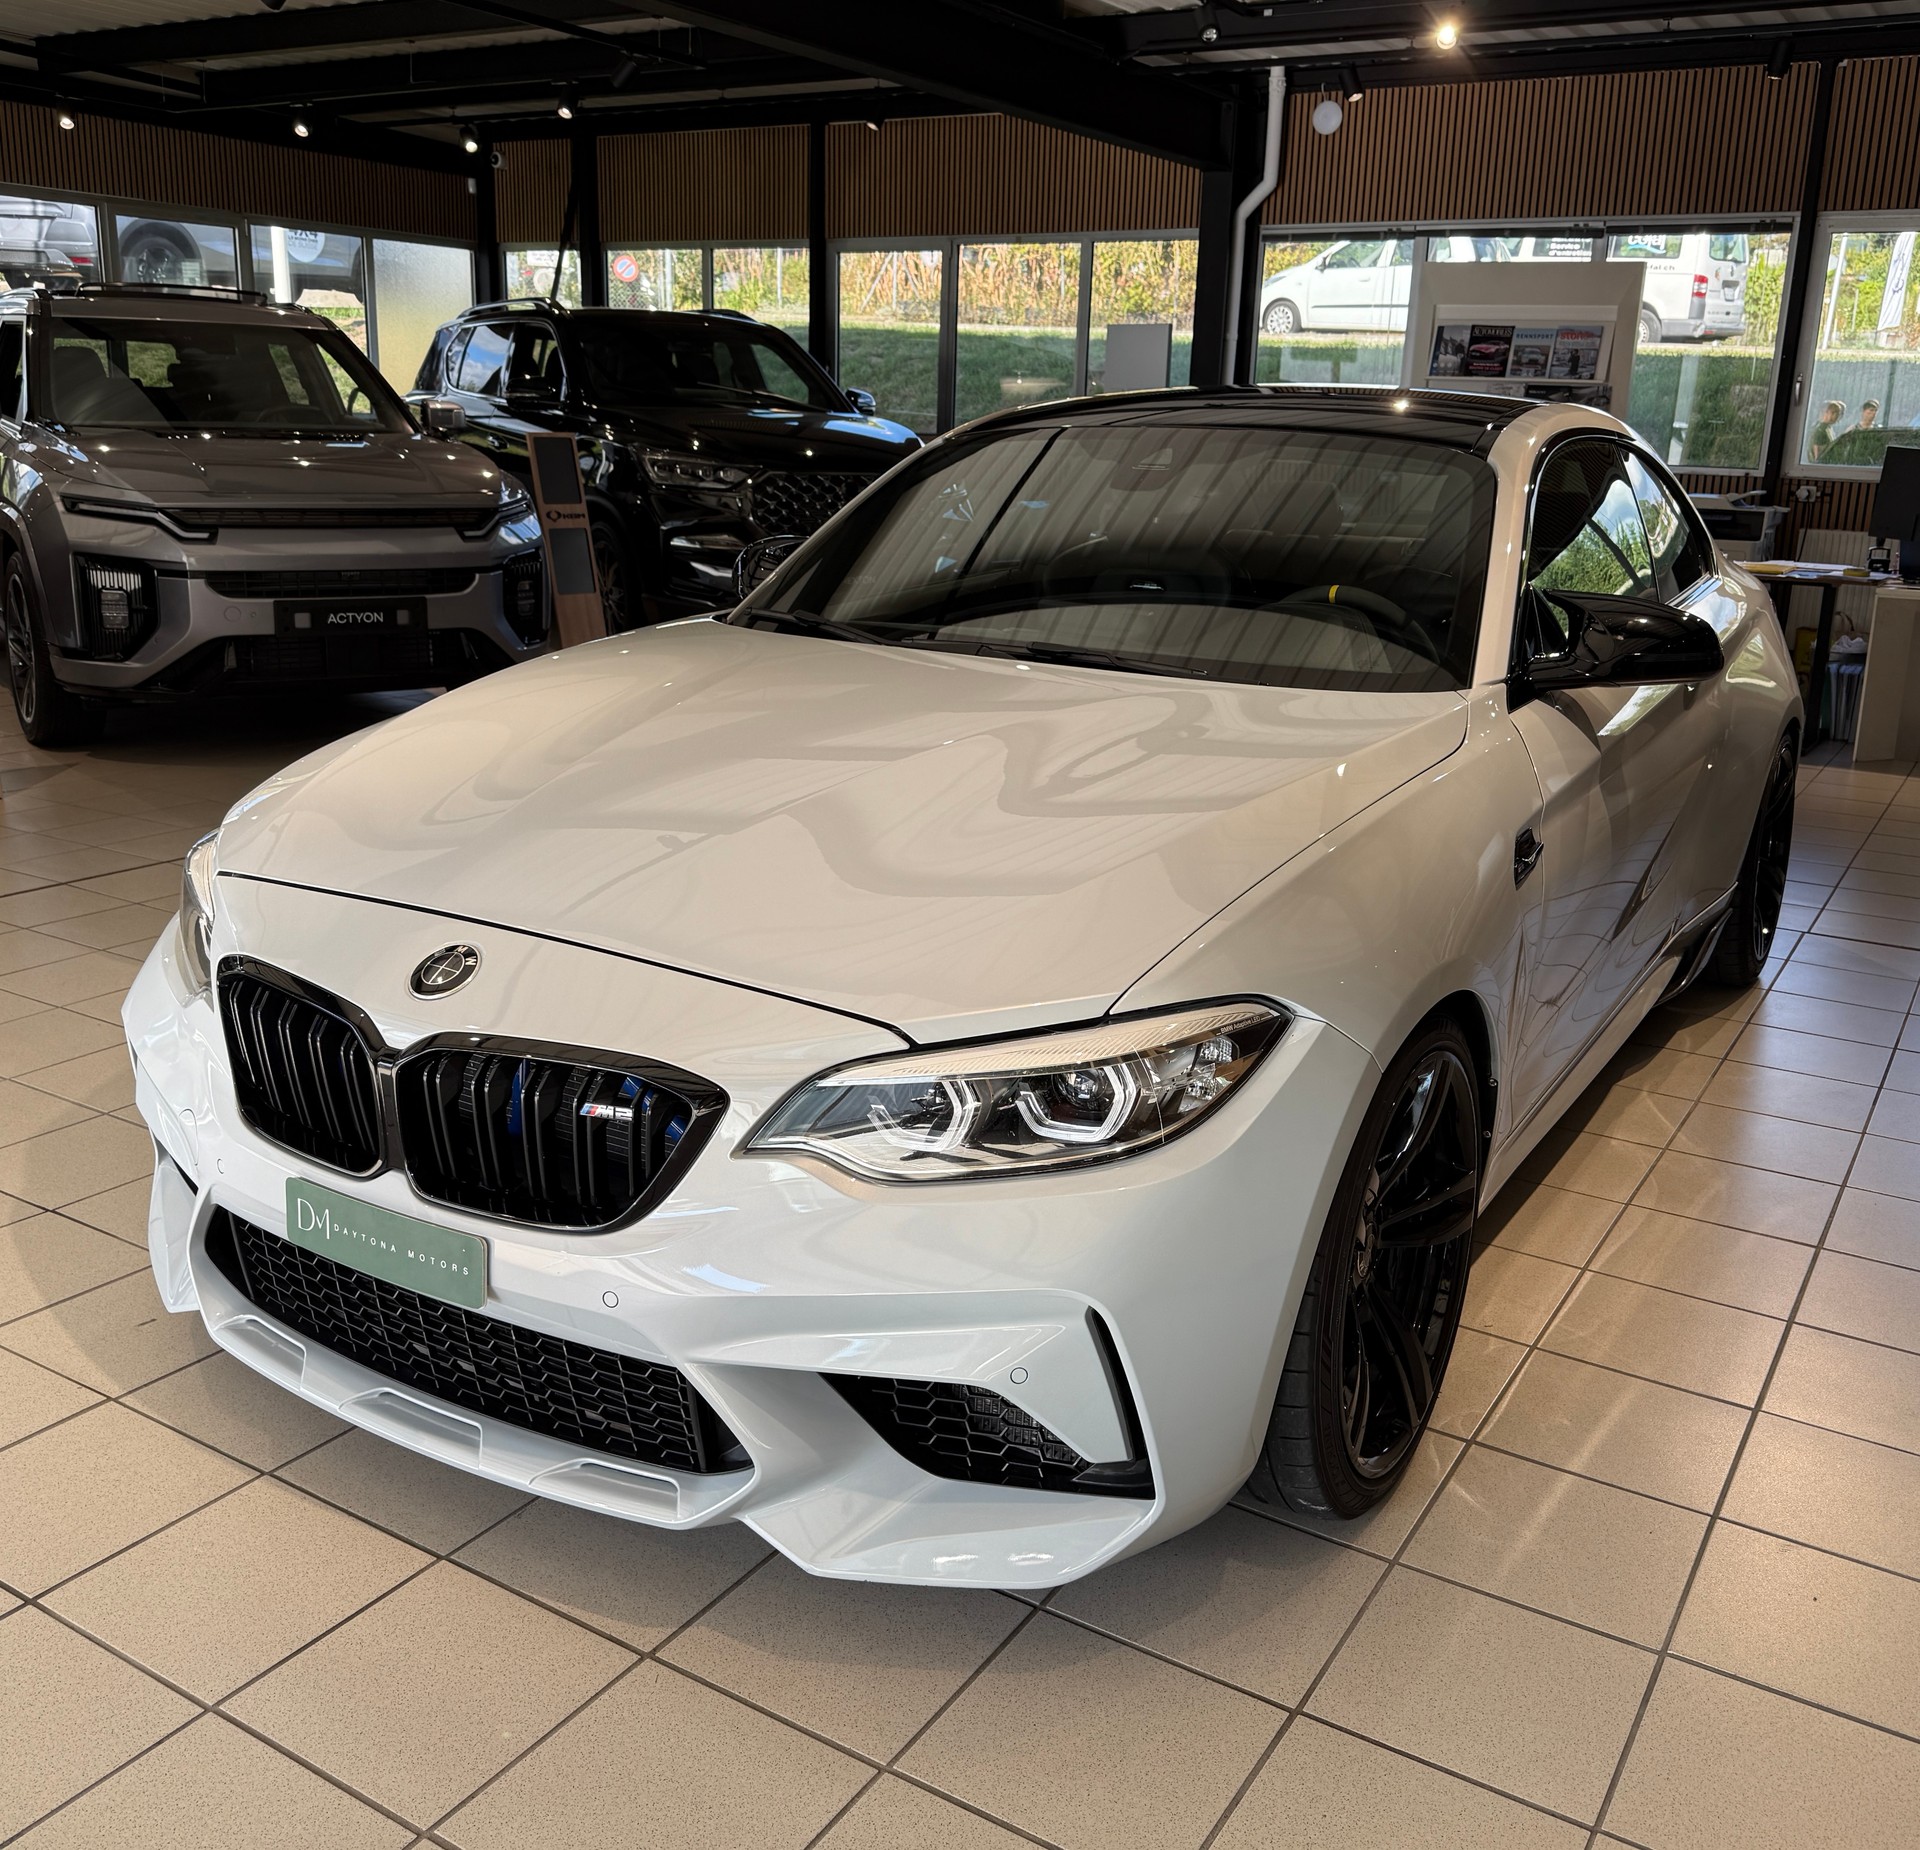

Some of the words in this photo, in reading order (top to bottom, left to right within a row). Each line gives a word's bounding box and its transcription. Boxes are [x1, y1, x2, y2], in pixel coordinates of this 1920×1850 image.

[327, 612, 384, 624] ACTYON
[1220, 1024, 1233, 1033] BMW
[594, 1104, 633, 1121] M2
[333, 1223, 397, 1253] DAYTONA
[407, 1249, 469, 1276] MOTORS
